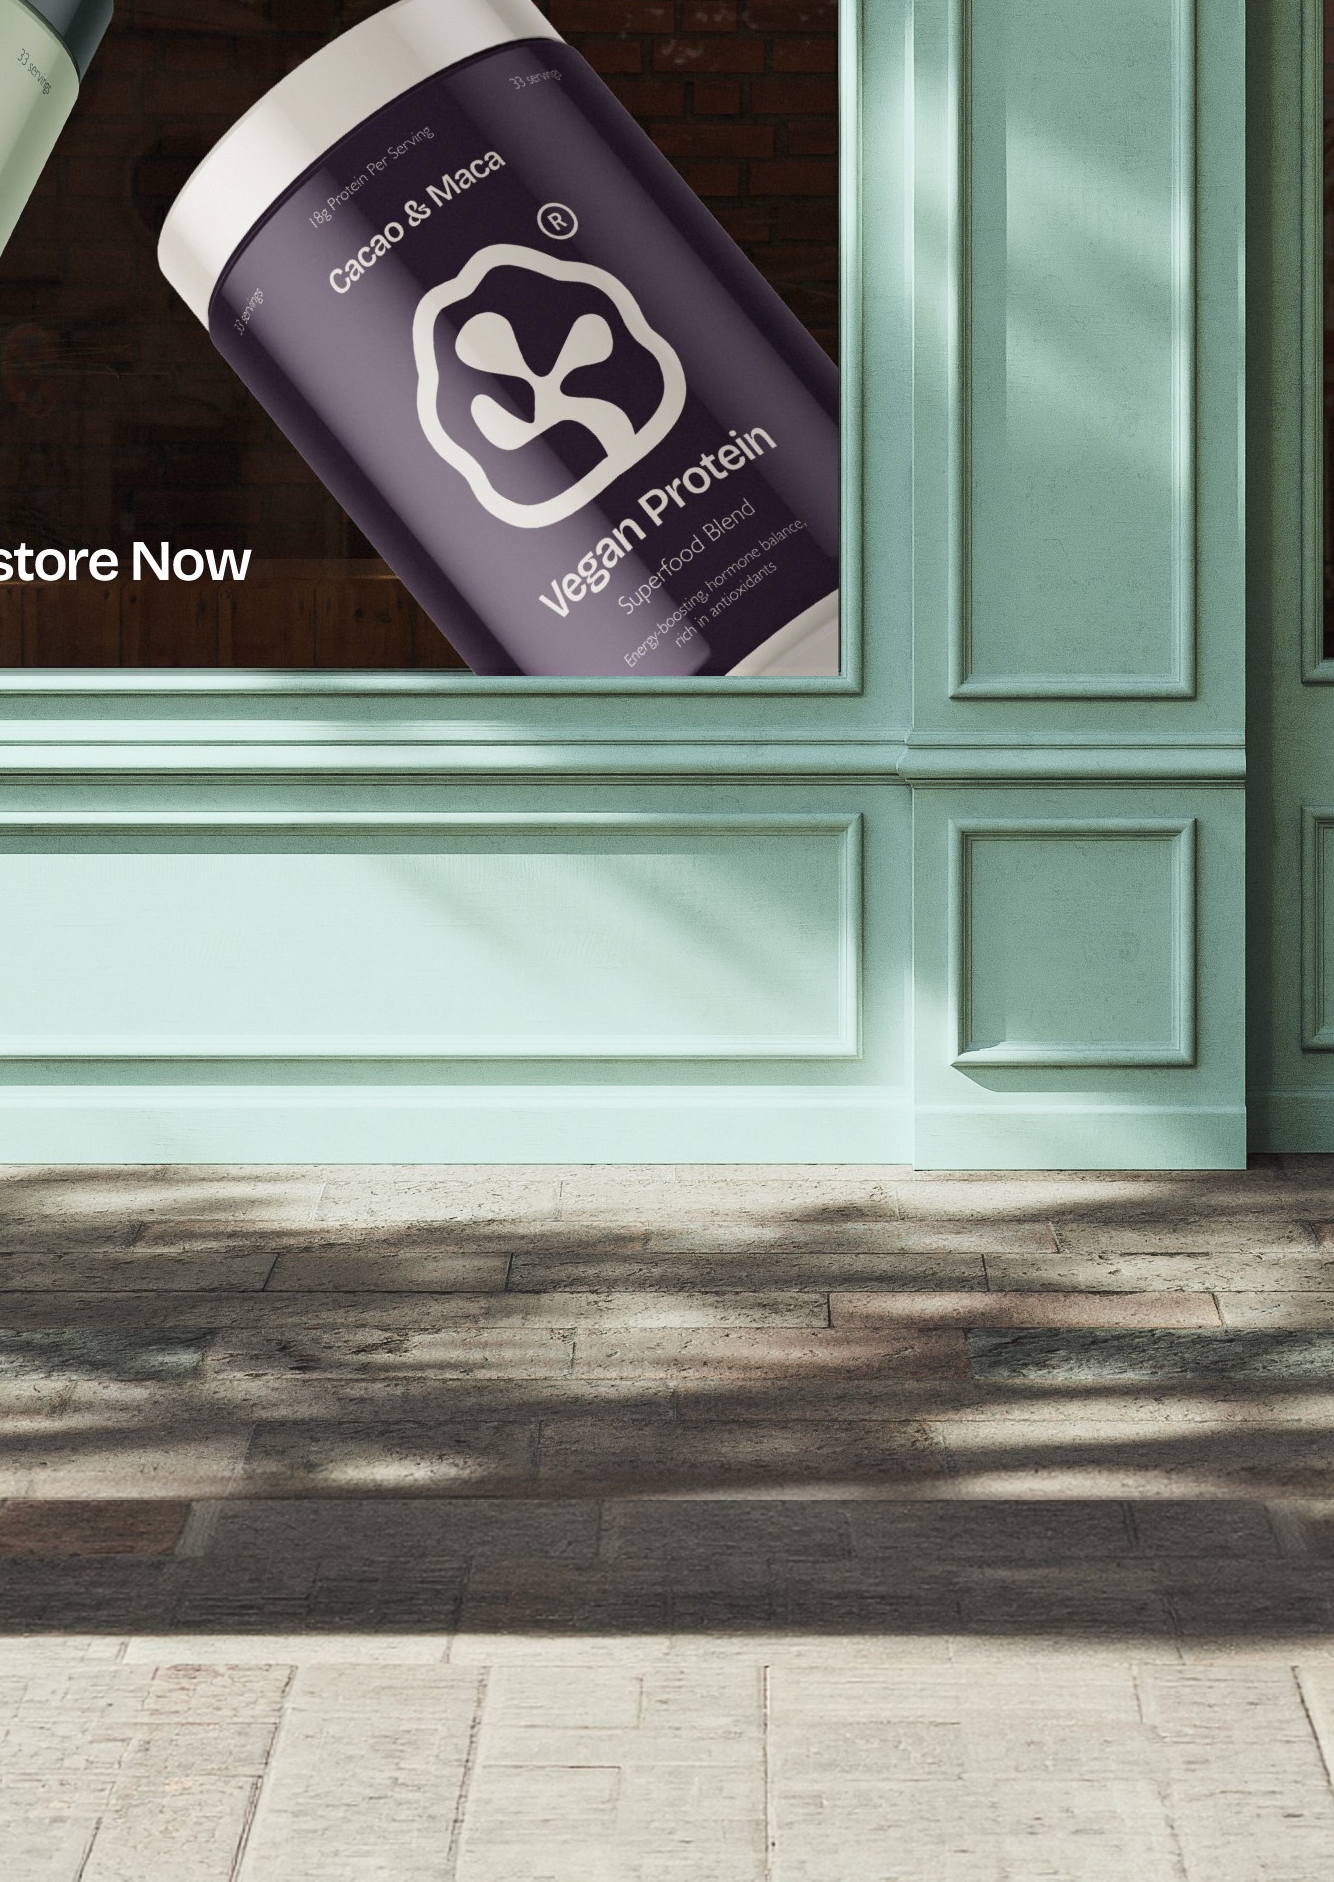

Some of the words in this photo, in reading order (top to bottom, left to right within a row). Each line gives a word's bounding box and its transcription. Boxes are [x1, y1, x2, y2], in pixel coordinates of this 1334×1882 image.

[17, 48, 30, 66] 33
[28, 63, 52, 95] servings
[509, 76, 526, 89] 33
[309, 208, 333, 228] 18g
[327, 174, 369, 211] Protein
[366, 156, 388, 176] Per
[387, 126, 435, 160] Serving
[329, 221, 405, 294] Cacao
[404, 200, 432, 227] &
[425, 151, 506, 207] Maca
[132, 541, 253, 582] Now
[538, 518, 647, 619] Vegan
[637, 426, 778, 527] Protein
[618, 534, 706, 615] Superfood
[702, 498, 756, 542] Blend
[623, 589, 710, 668] Energy-boosting,
[705, 547, 761, 593] hormone
[759, 519, 808, 552] balance,
[675, 624, 698, 649] rich
[694, 614, 710, 628] in
[709, 561, 778, 618] antioxidants
